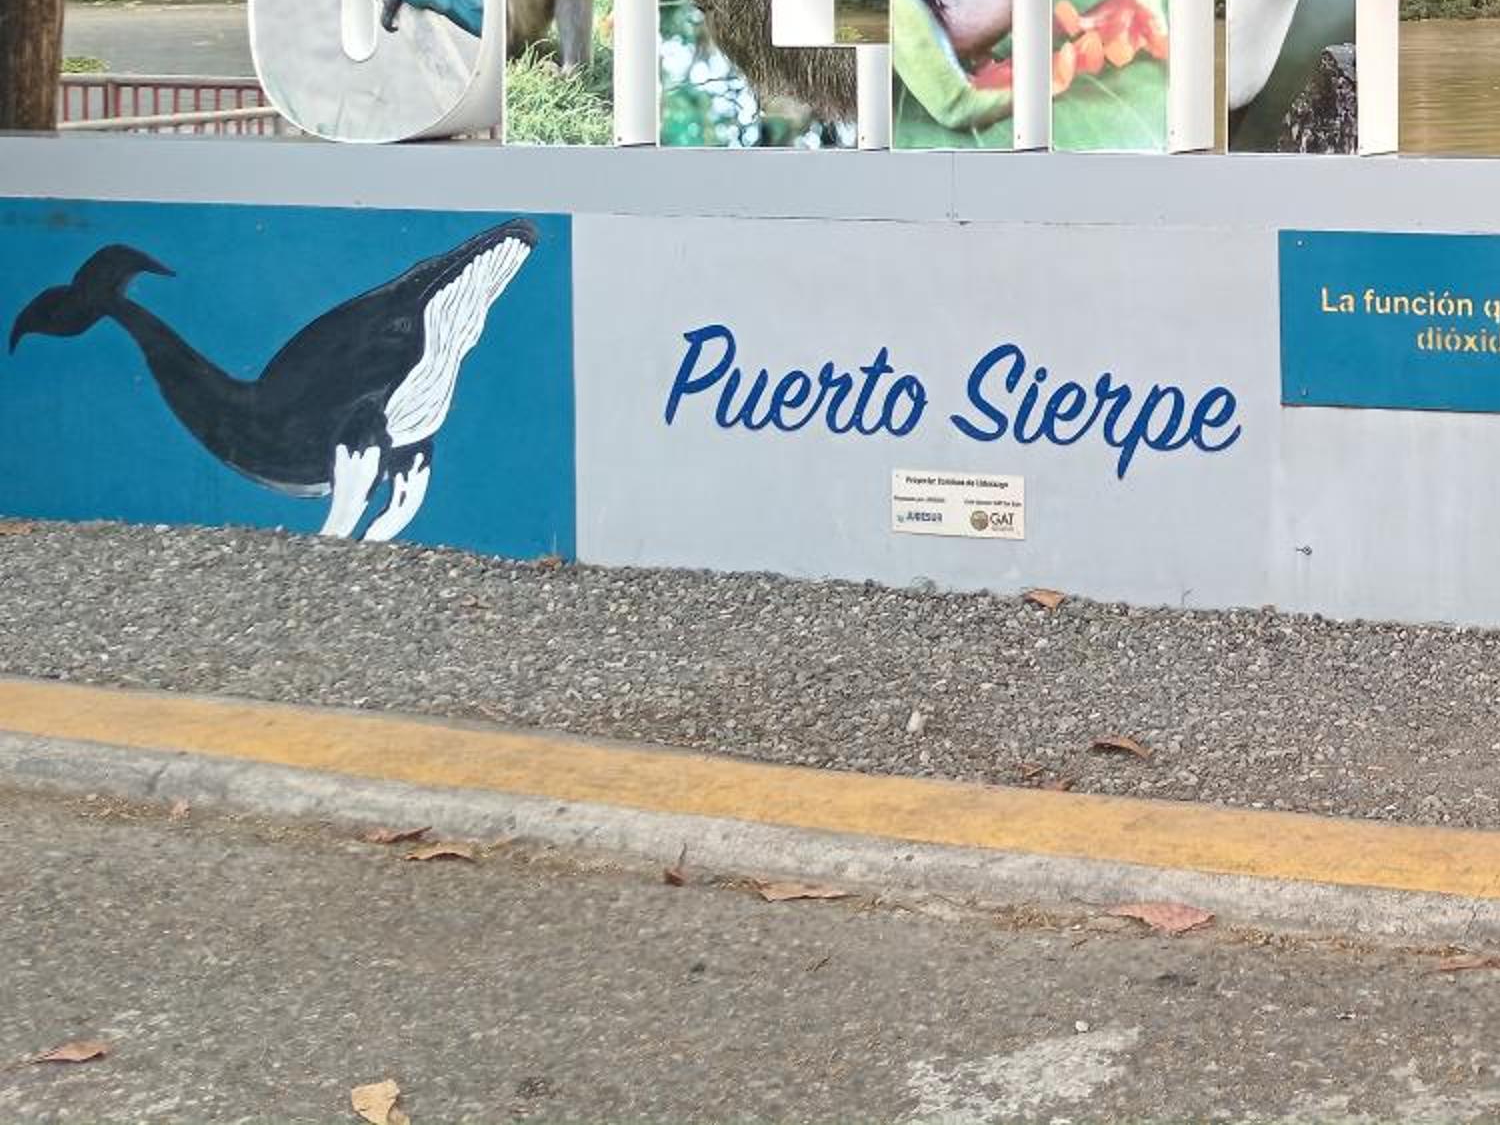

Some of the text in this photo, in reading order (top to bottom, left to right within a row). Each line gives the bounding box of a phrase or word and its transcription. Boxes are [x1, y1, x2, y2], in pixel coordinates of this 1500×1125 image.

[1320, 286, 1355, 313] La
[1363, 287, 1474, 318] función
[664, 324, 1242, 481] Puerto Sierpe
